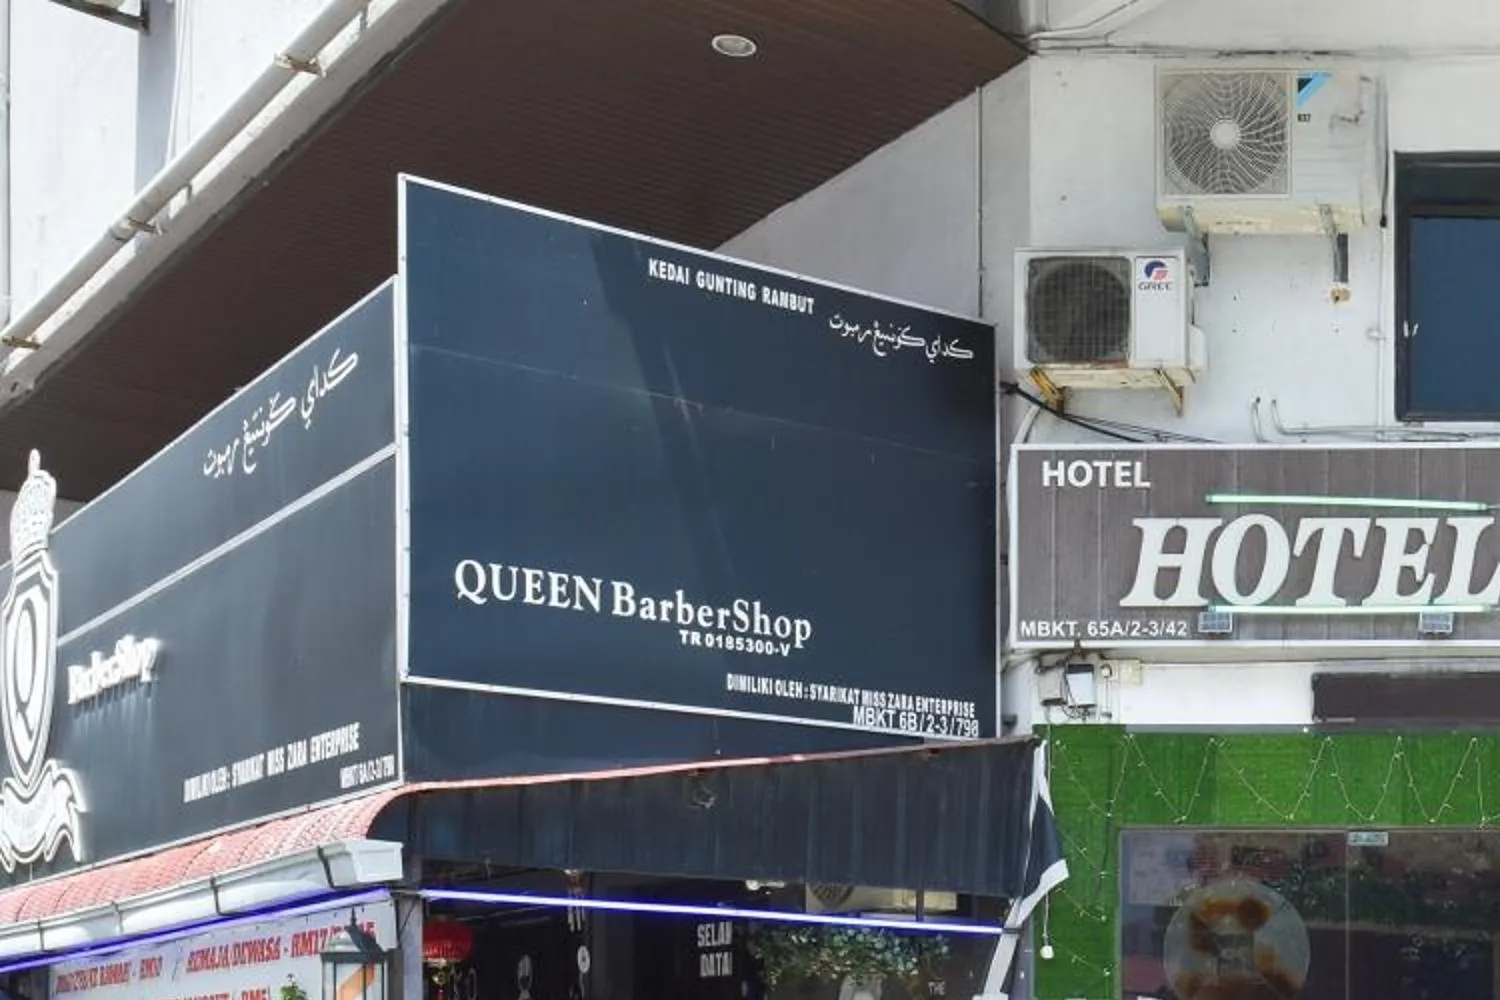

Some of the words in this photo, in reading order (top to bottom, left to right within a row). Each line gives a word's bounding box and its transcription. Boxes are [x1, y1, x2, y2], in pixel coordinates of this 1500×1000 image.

[649, 258, 690, 285] KEDAI
[695, 269, 757, 301] GUNTING
[761, 286, 815, 315] RAMBUT
[1042, 460, 1151, 489] HOTEL
[455, 559, 603, 613] QUEEN
[611, 579, 812, 649] BarberShop
[679, 629, 701, 646] TR
[704, 633, 791, 657] 0185300-V
[1086, 619, 1188, 638] 65A/2-3/42
[726, 672, 772, 697] DIMILIKI
[810, 684, 860, 705] SYARIKAT
[887, 692, 914, 711] ZARA
[915, 695, 976, 719] ENTERPRISE
[853, 705, 896, 729] MBKT
